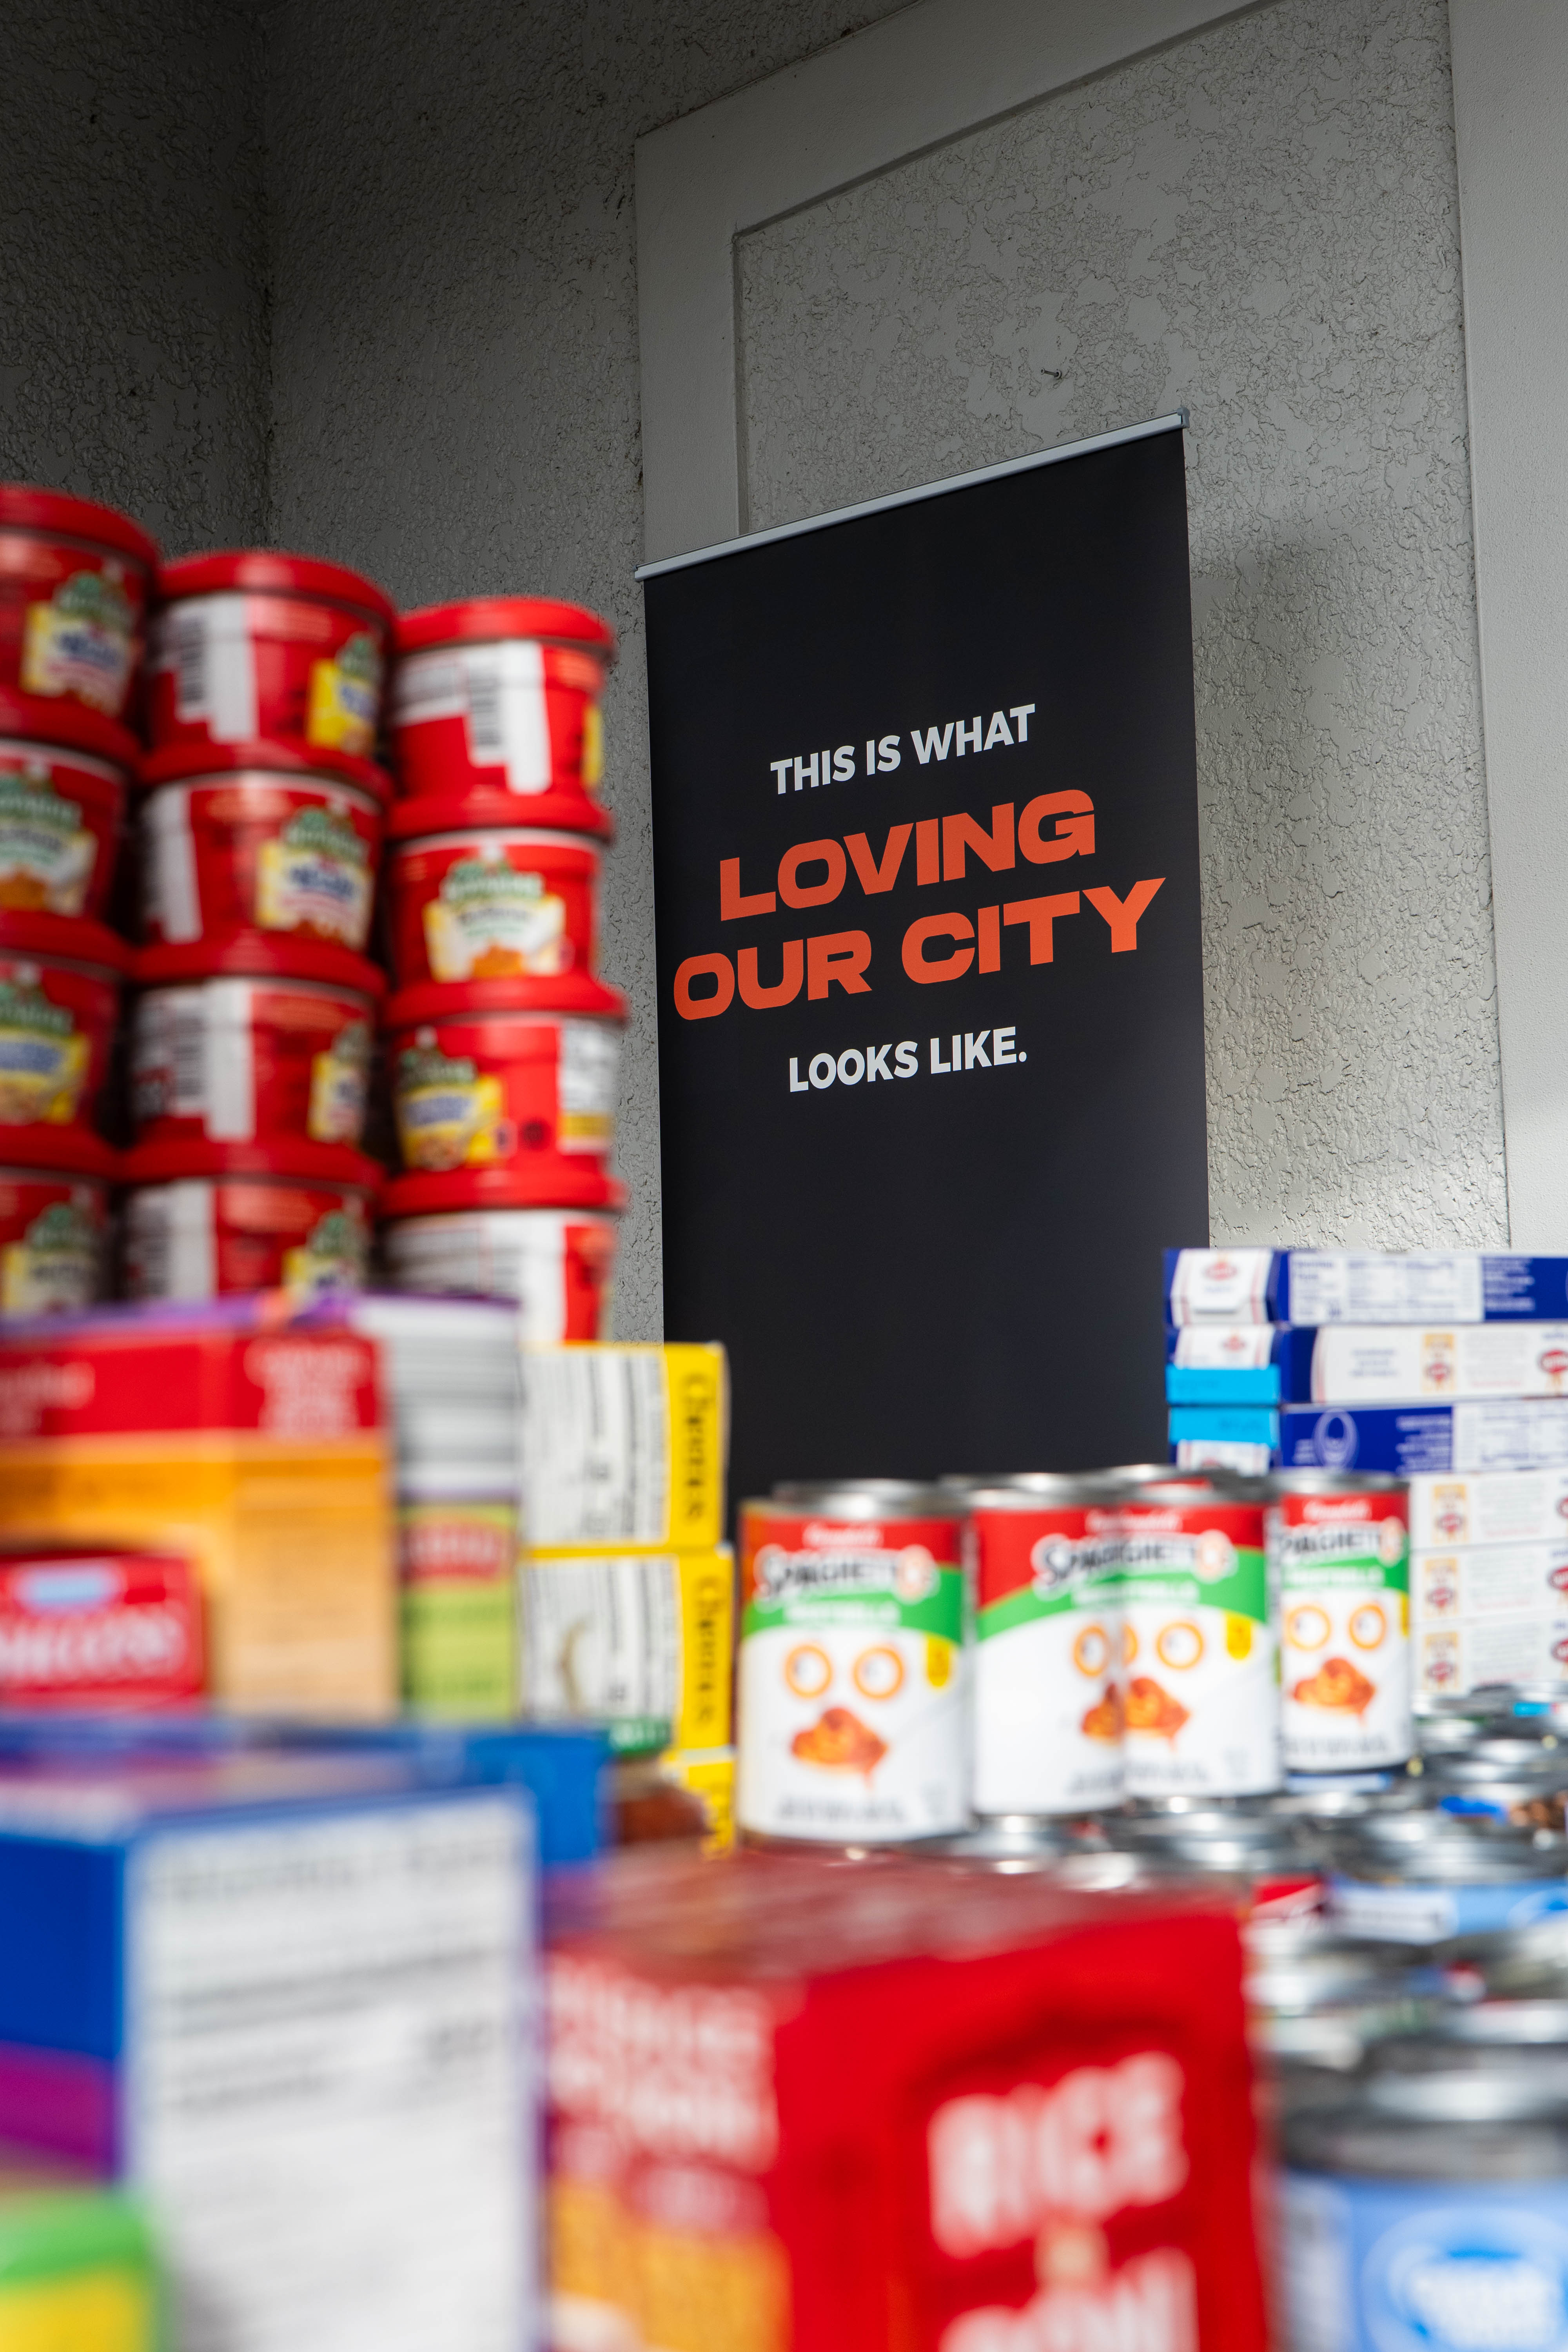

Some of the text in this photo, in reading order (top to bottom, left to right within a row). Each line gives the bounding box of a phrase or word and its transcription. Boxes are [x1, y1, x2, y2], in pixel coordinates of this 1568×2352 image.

[770, 703, 1035, 795] THIS IS WHAT
[720, 789, 1095, 921] LOVING
[674, 877, 1166, 1020] OUR CITY
[789, 1026, 1027, 1093] LOOKS LIKE.
